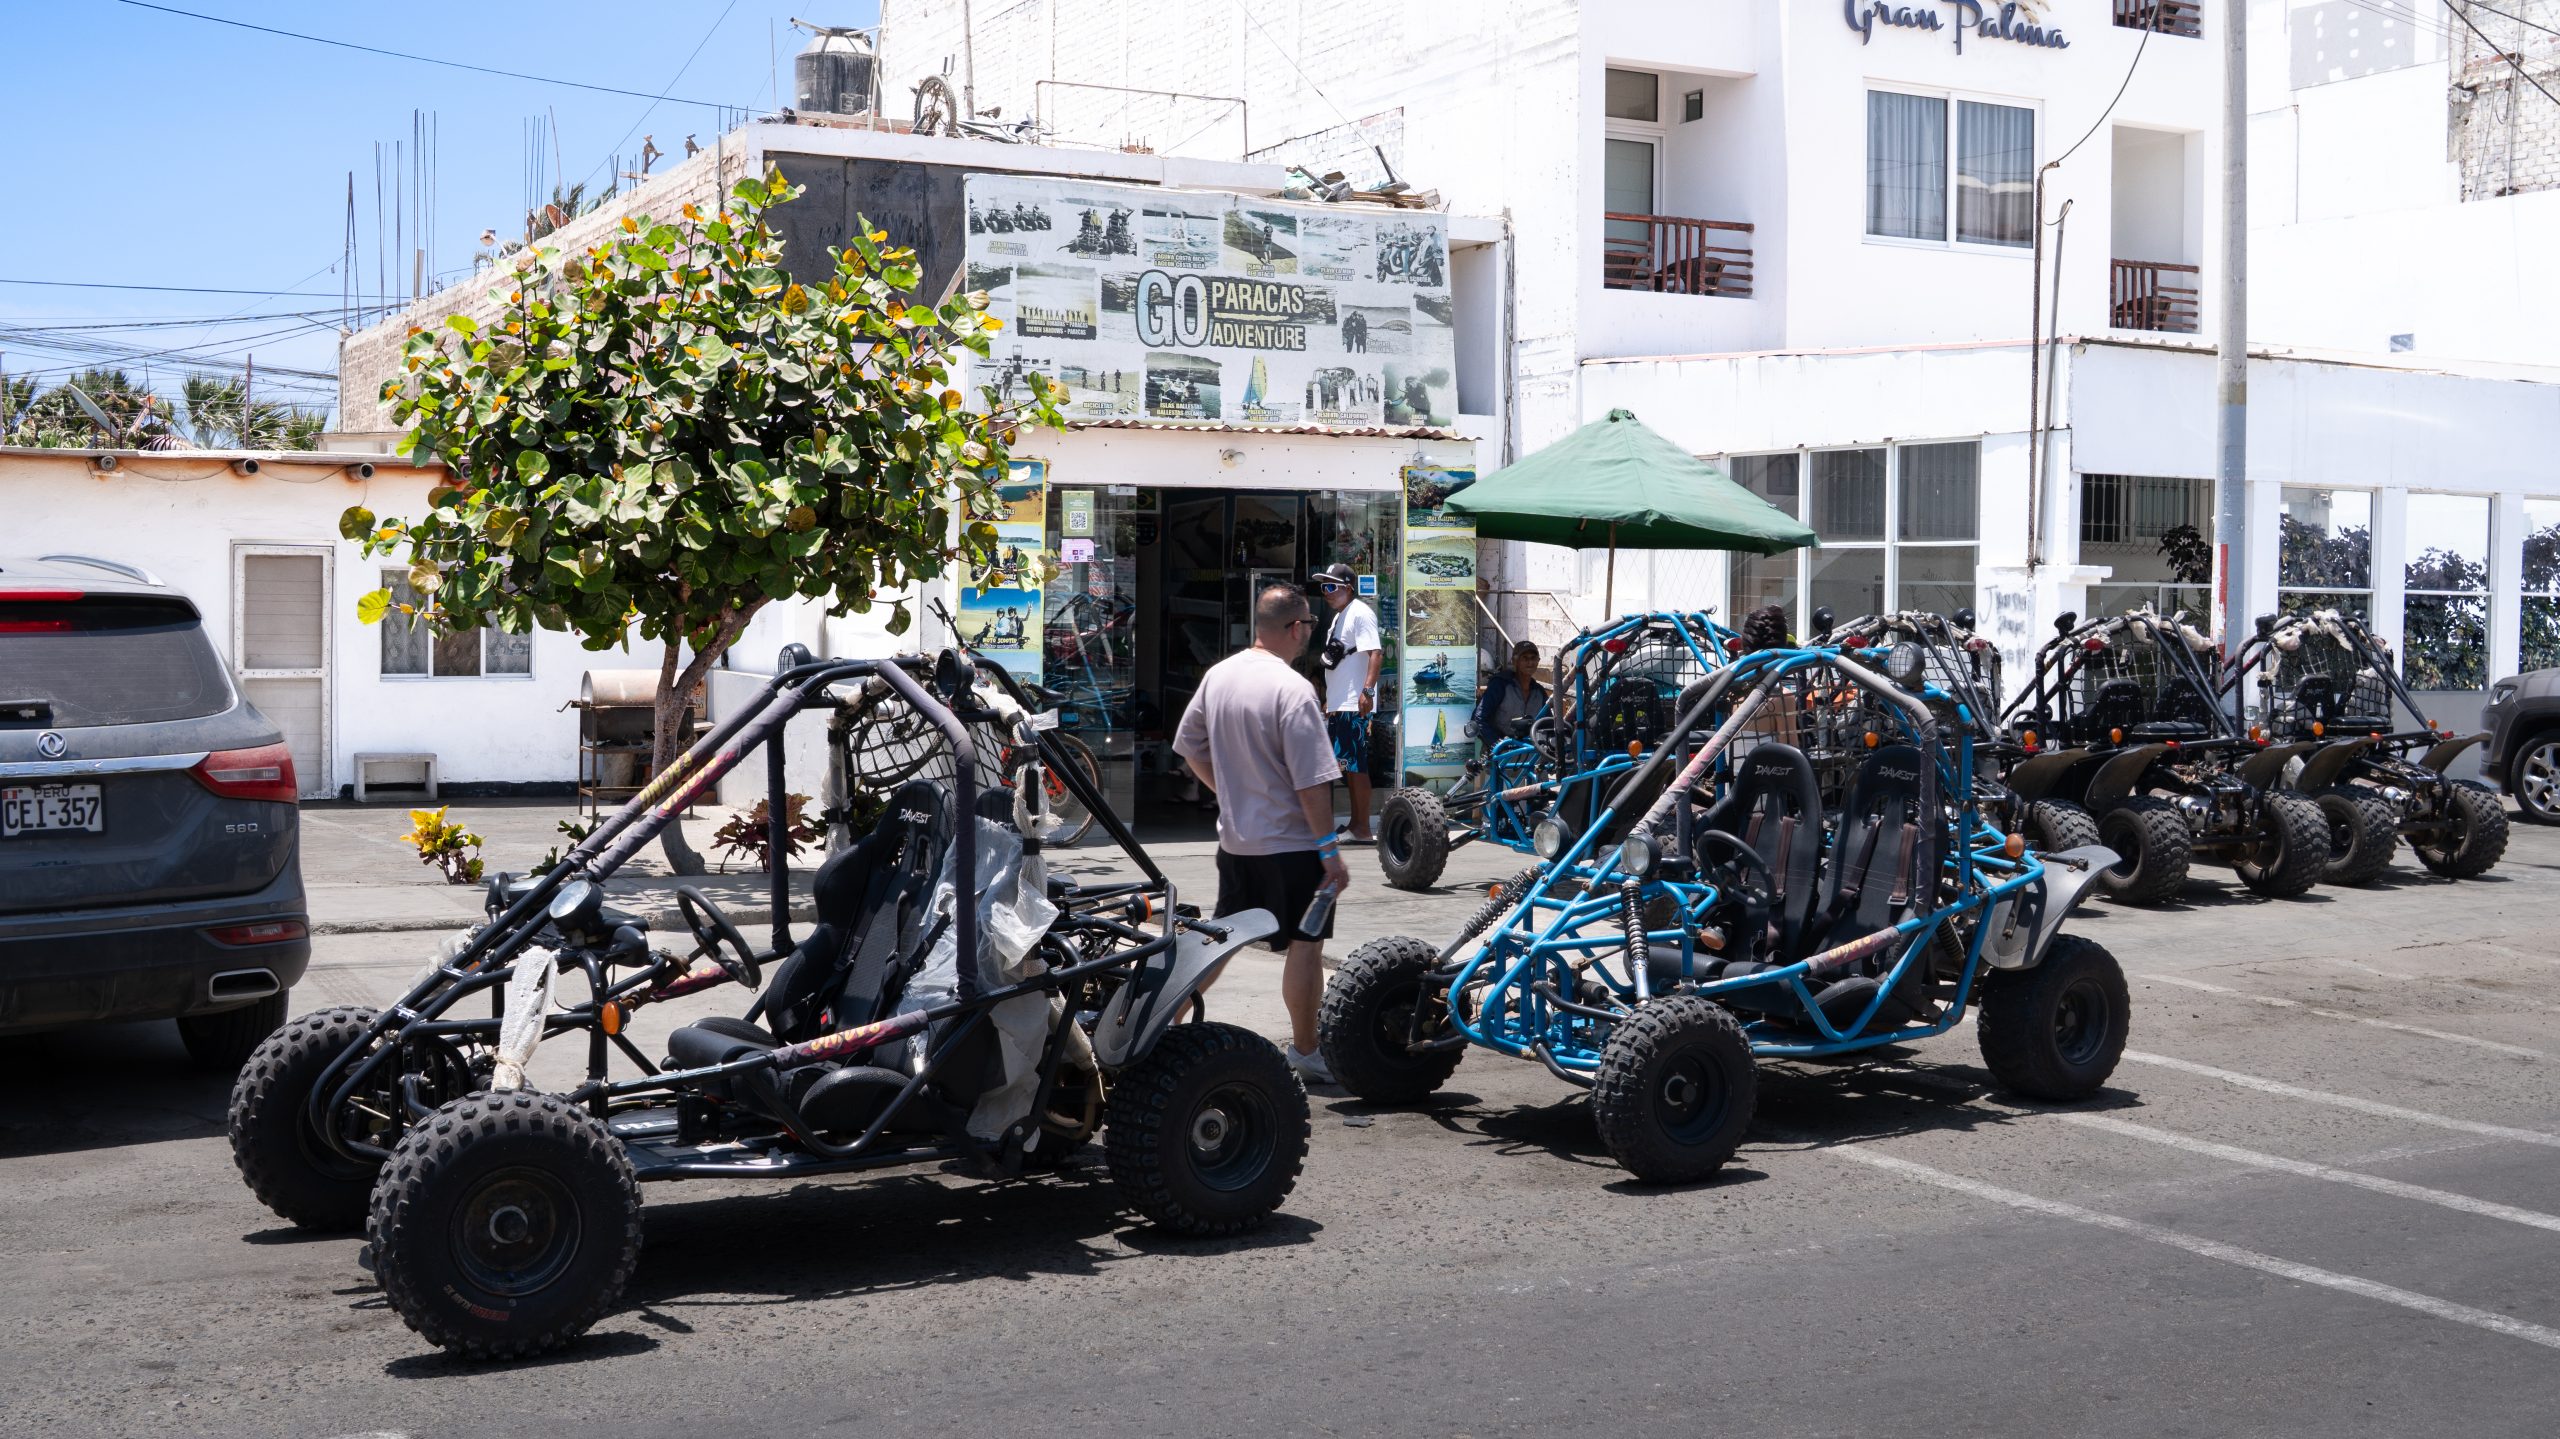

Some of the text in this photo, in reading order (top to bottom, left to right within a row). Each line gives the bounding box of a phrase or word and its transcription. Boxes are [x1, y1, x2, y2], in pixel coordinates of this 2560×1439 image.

[1845, 0, 2070, 56] Gran Palma
[1212, 282, 1304, 314] PARACAS
[1135, 269, 1210, 347] GO
[1067, 328, 1086, 336] PARACAS
[1210, 323, 1306, 350] ADVENTURE
[1083, 401, 1113, 409] BICICLETAS
[1089, 408, 1106, 416] BIKES
[1754, 764, 1795, 776] DAVEST
[1878, 765, 1919, 782] DAVEST
[33, 787, 70, 799] PERU
[5, 796, 100, 830] CEI-357
[898, 808, 932, 824] DAVEST
[225, 822, 258, 833] 580
